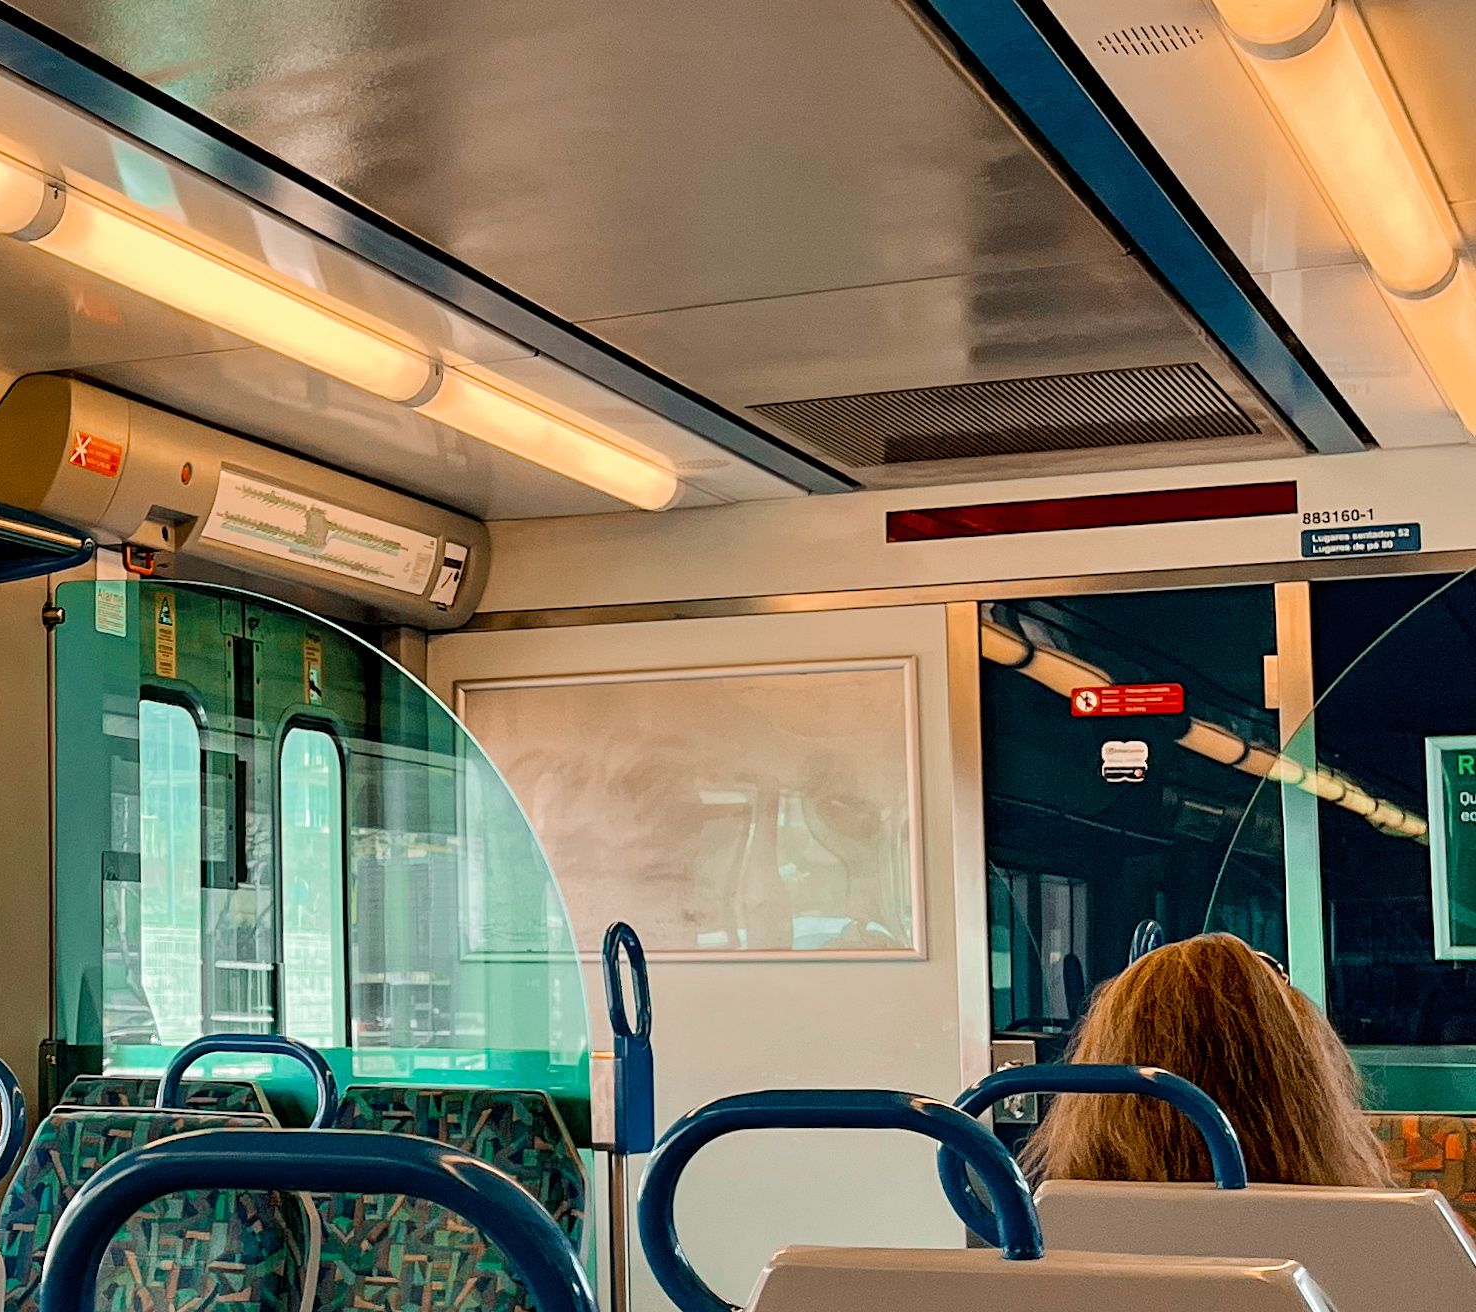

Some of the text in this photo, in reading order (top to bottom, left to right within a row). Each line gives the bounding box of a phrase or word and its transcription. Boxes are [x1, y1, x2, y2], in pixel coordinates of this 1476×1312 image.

[1303, 509, 1374, 524] 883160-1
[1311, 533, 1351, 544] Lugares
[1352, 530, 1396, 540] sentados
[1312, 544, 1351, 554] Lugares
[1352, 542, 1365, 551] de
